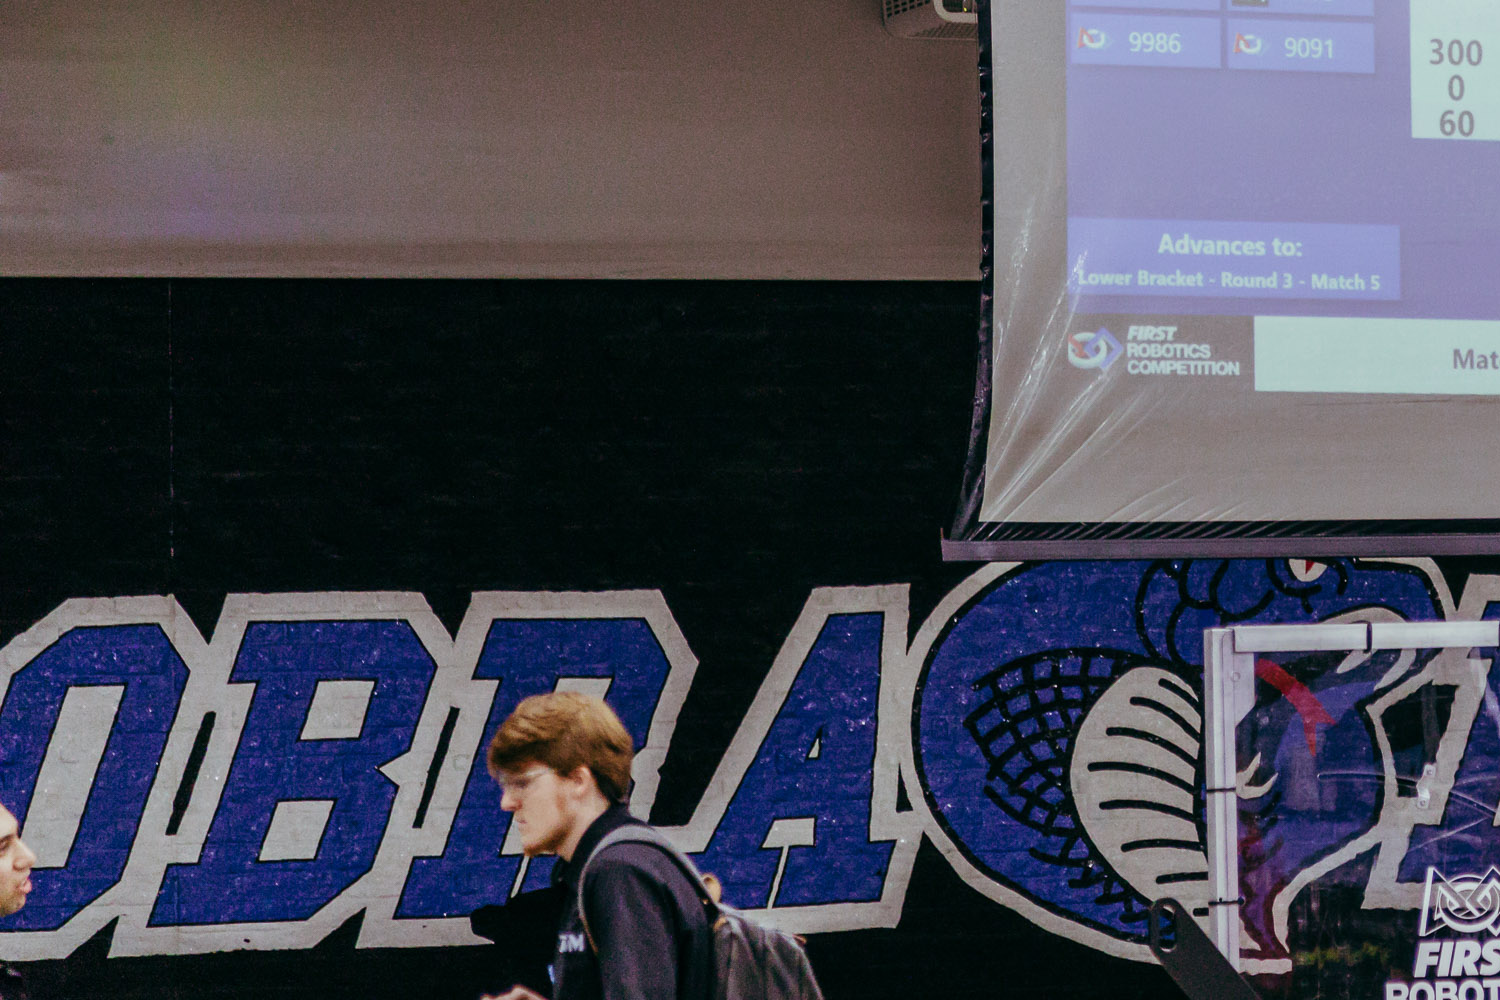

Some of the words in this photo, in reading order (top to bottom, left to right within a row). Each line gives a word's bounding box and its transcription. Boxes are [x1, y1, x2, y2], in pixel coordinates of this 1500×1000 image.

[1129, 31, 1181, 53] 9986
[1284, 38, 1334, 59] 9091
[1429, 38, 1483, 67] 300
[1449, 74, 1464, 101] 0
[1439, 110, 1474, 137] 60
[1158, 234, 1265, 256] Advances
[1272, 237, 1303, 256] to:
[1078, 268, 1132, 287] Lower
[1138, 270, 1203, 288] Bracket
[1221, 271, 1278, 289] Round
[1283, 273, 1293, 289] 3
[1311, 273, 1364, 290] Match
[1370, 274, 1381, 290] 5
[1128, 326, 1177, 341] FIRST
[1127, 343, 1211, 358] ROBOTICS
[1127, 359, 1240, 375] COMPETITION
